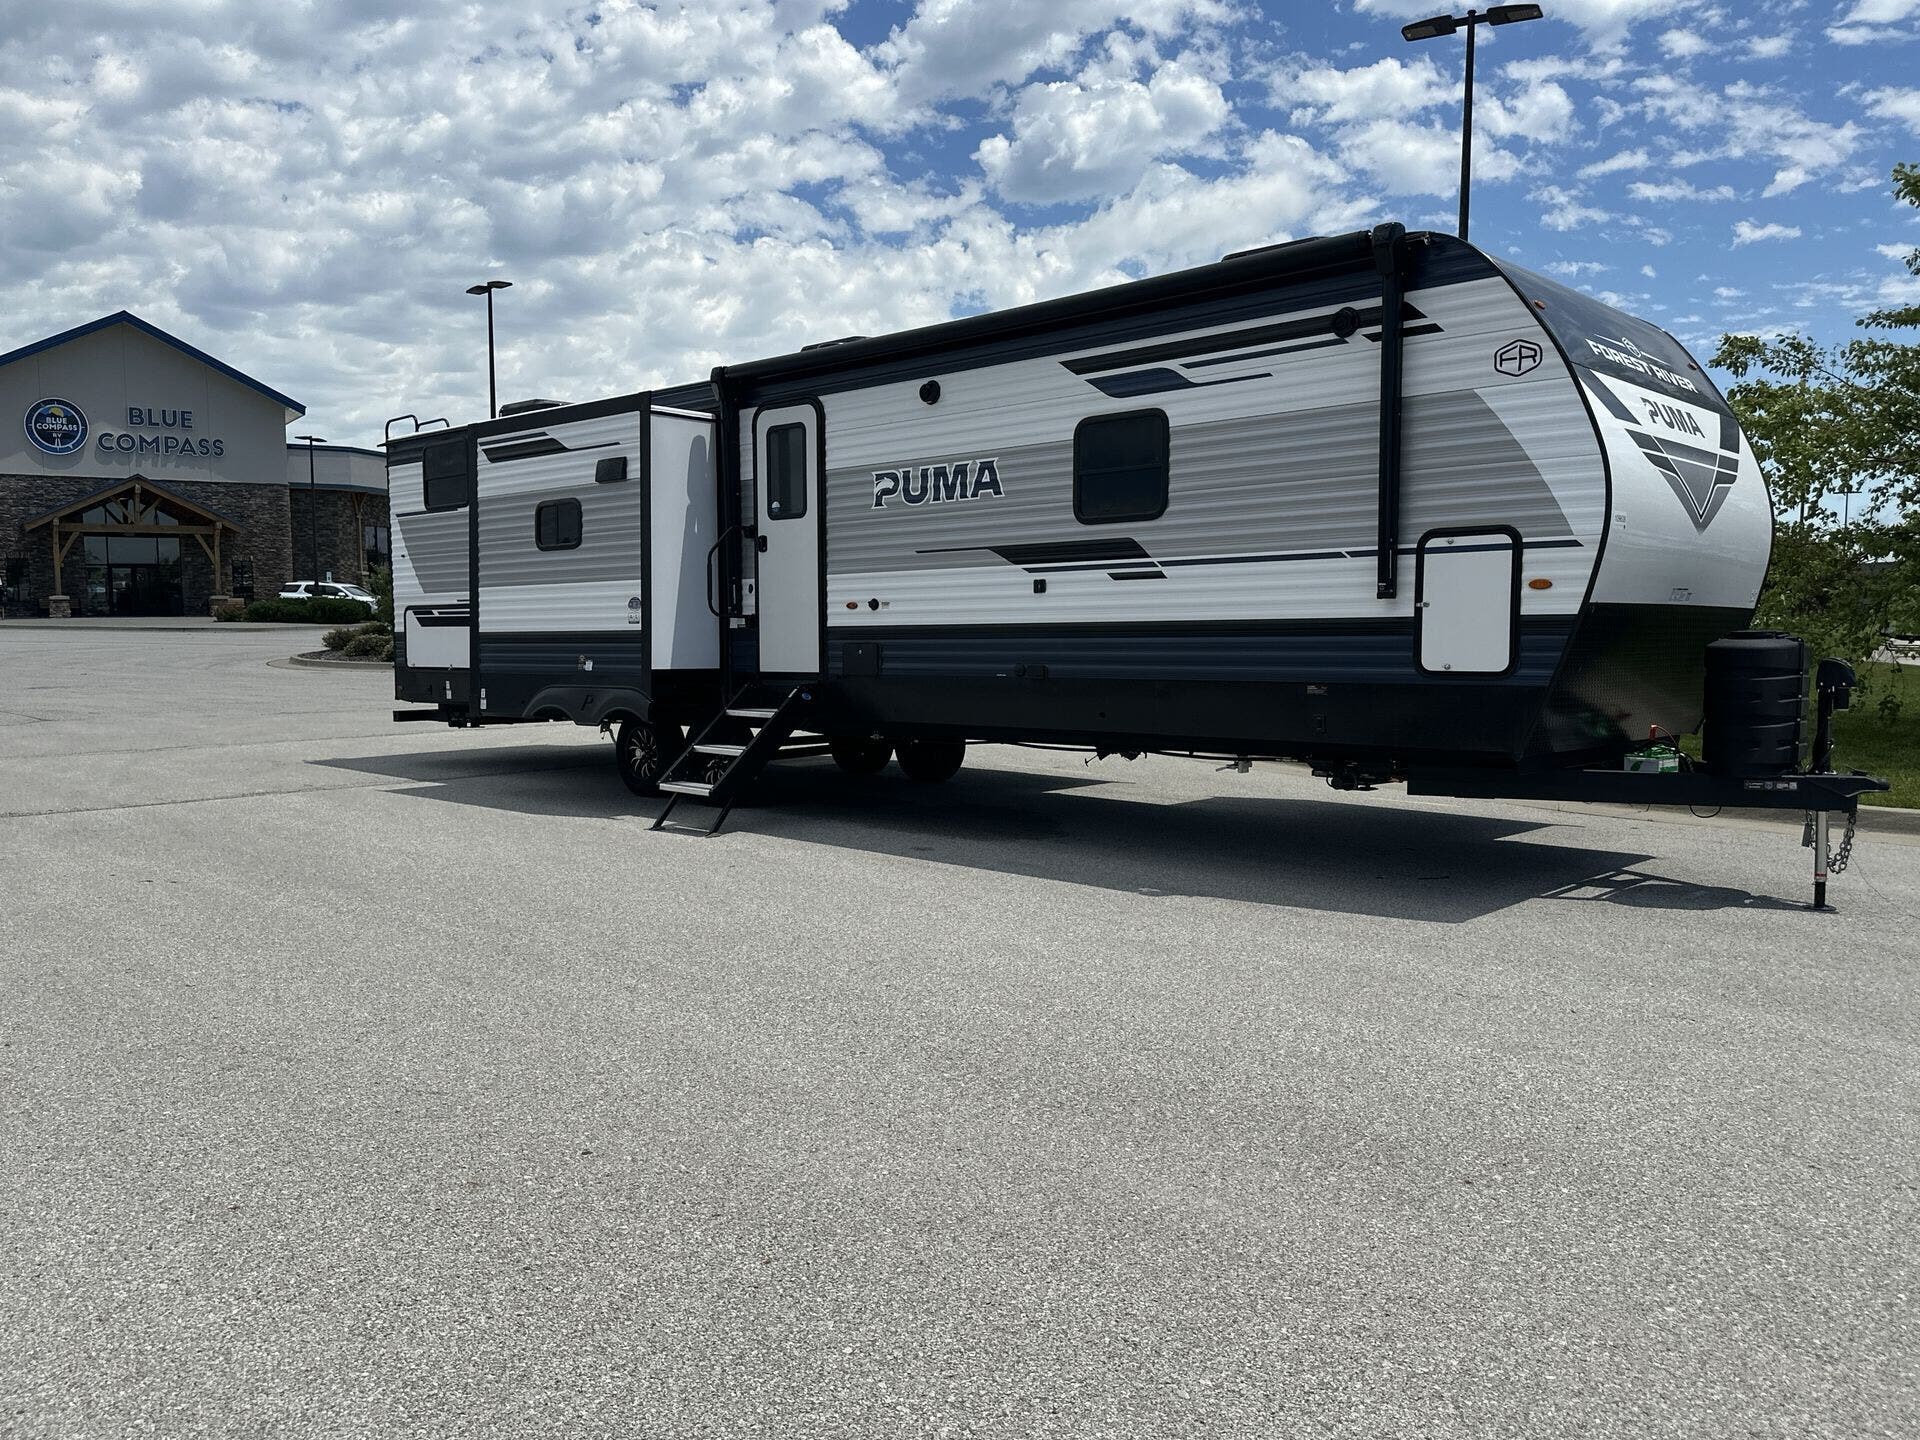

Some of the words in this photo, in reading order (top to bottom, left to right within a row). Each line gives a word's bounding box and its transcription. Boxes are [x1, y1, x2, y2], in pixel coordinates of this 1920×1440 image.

[1585, 338, 1652, 376] FOREST
[1648, 364, 1699, 394] RIVER
[36, 423, 78, 431] COMPASS
[45, 416, 67, 424] BLUE
[128, 406, 193, 429] BLUE
[1639, 396, 1706, 439] PUMA
[97, 432, 225, 457] COMPASS
[871, 456, 1005, 509] PUMA
